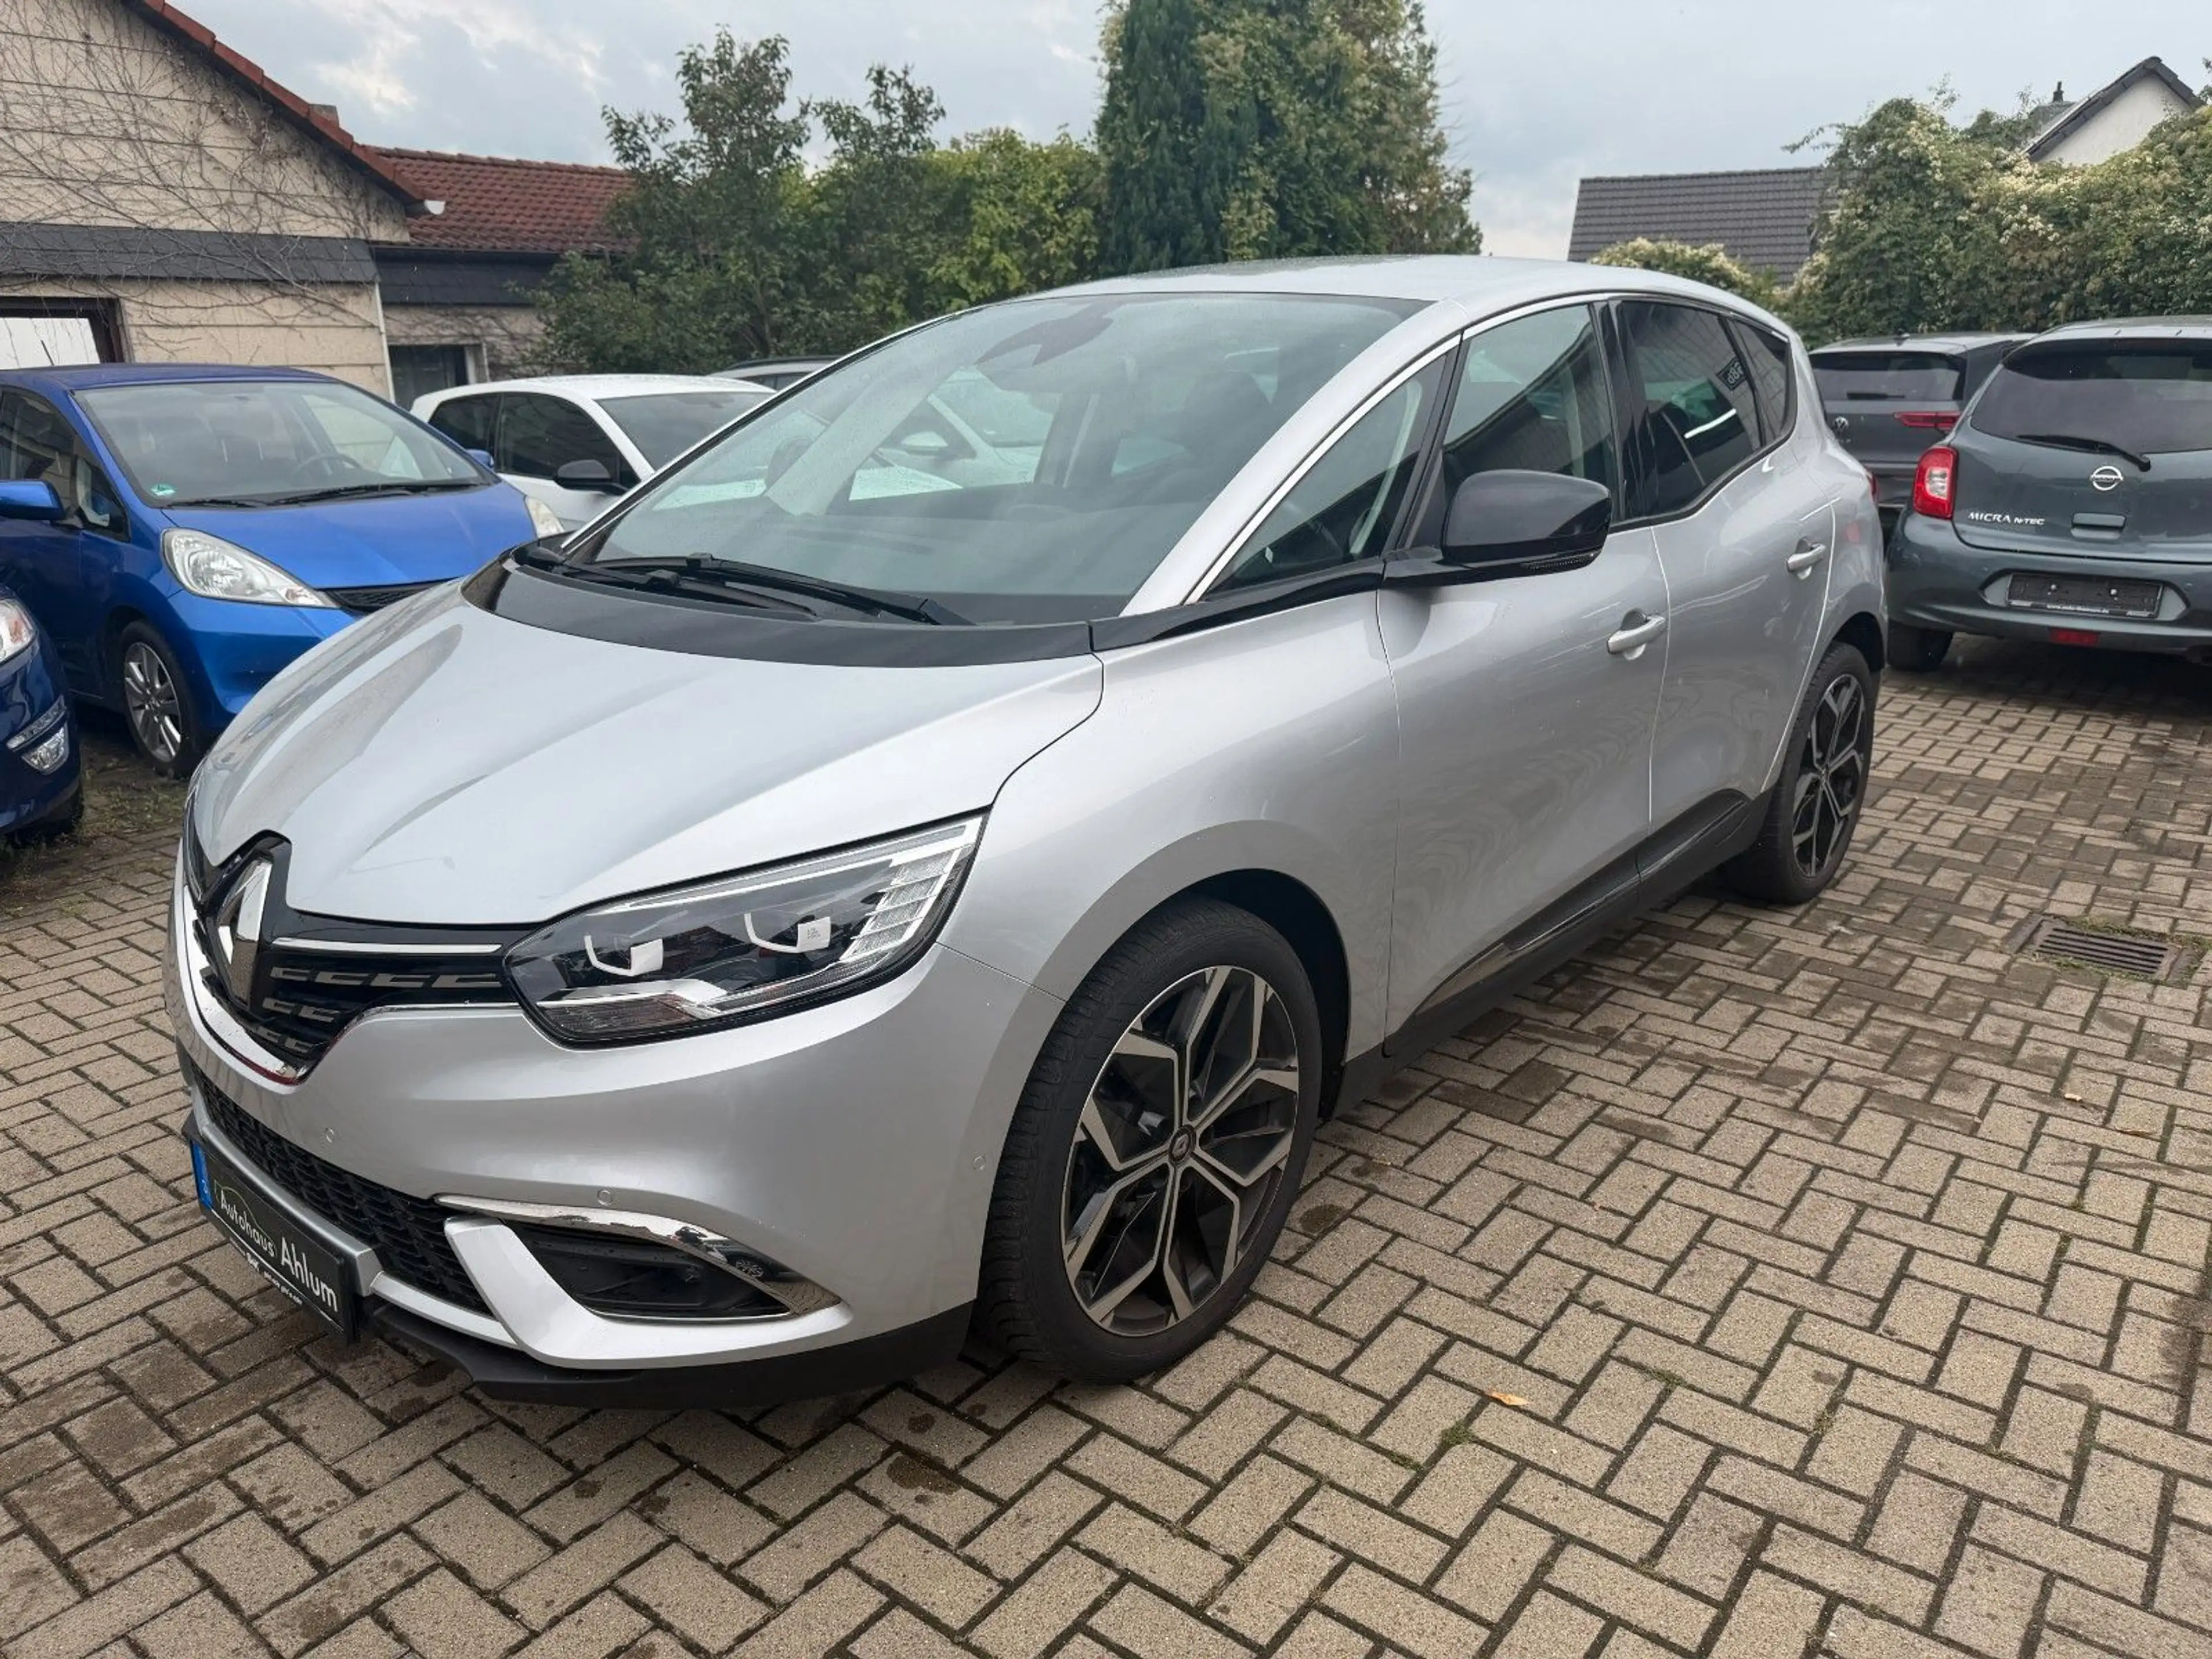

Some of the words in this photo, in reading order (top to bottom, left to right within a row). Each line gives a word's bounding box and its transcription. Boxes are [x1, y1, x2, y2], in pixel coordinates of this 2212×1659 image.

[1968, 511, 2011, 524] MICRA
[220, 1190, 275, 1257] Autohaus
[281, 1236, 338, 1313] Ahlum
